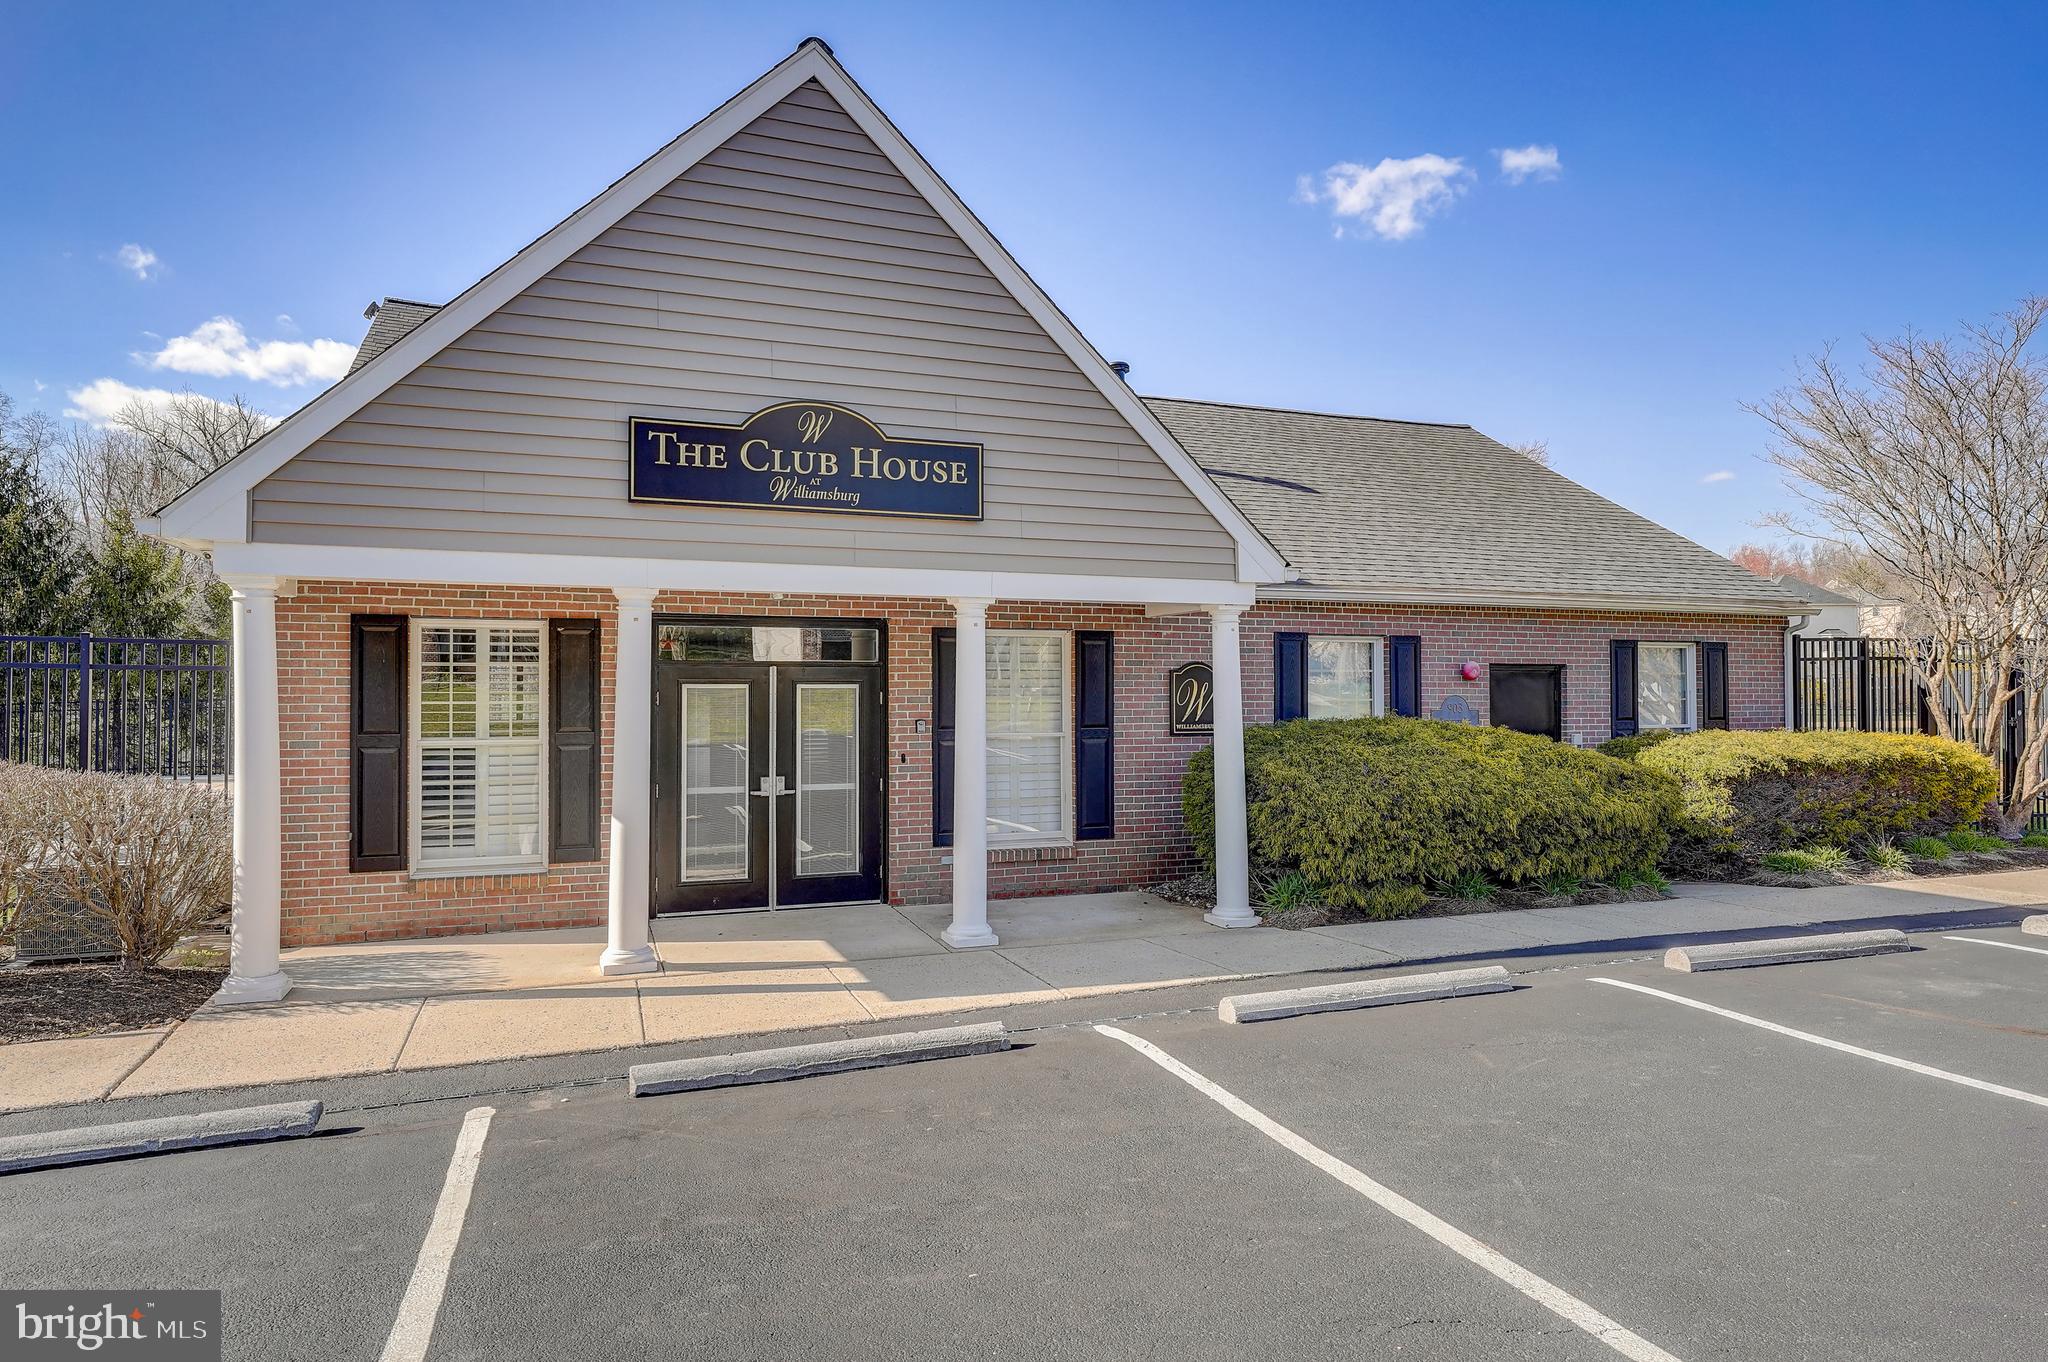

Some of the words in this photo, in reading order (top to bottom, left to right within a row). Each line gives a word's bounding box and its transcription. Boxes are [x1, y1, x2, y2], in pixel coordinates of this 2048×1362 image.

[798, 410, 833, 443] W
[648, 430, 728, 470] THE
[740, 439, 839, 476] CLUB
[850, 447, 968, 485] HOUSE
[769, 475, 860, 506] Williamsburg
[809, 478, 822, 486] AT
[1177, 678, 1213, 722] W
